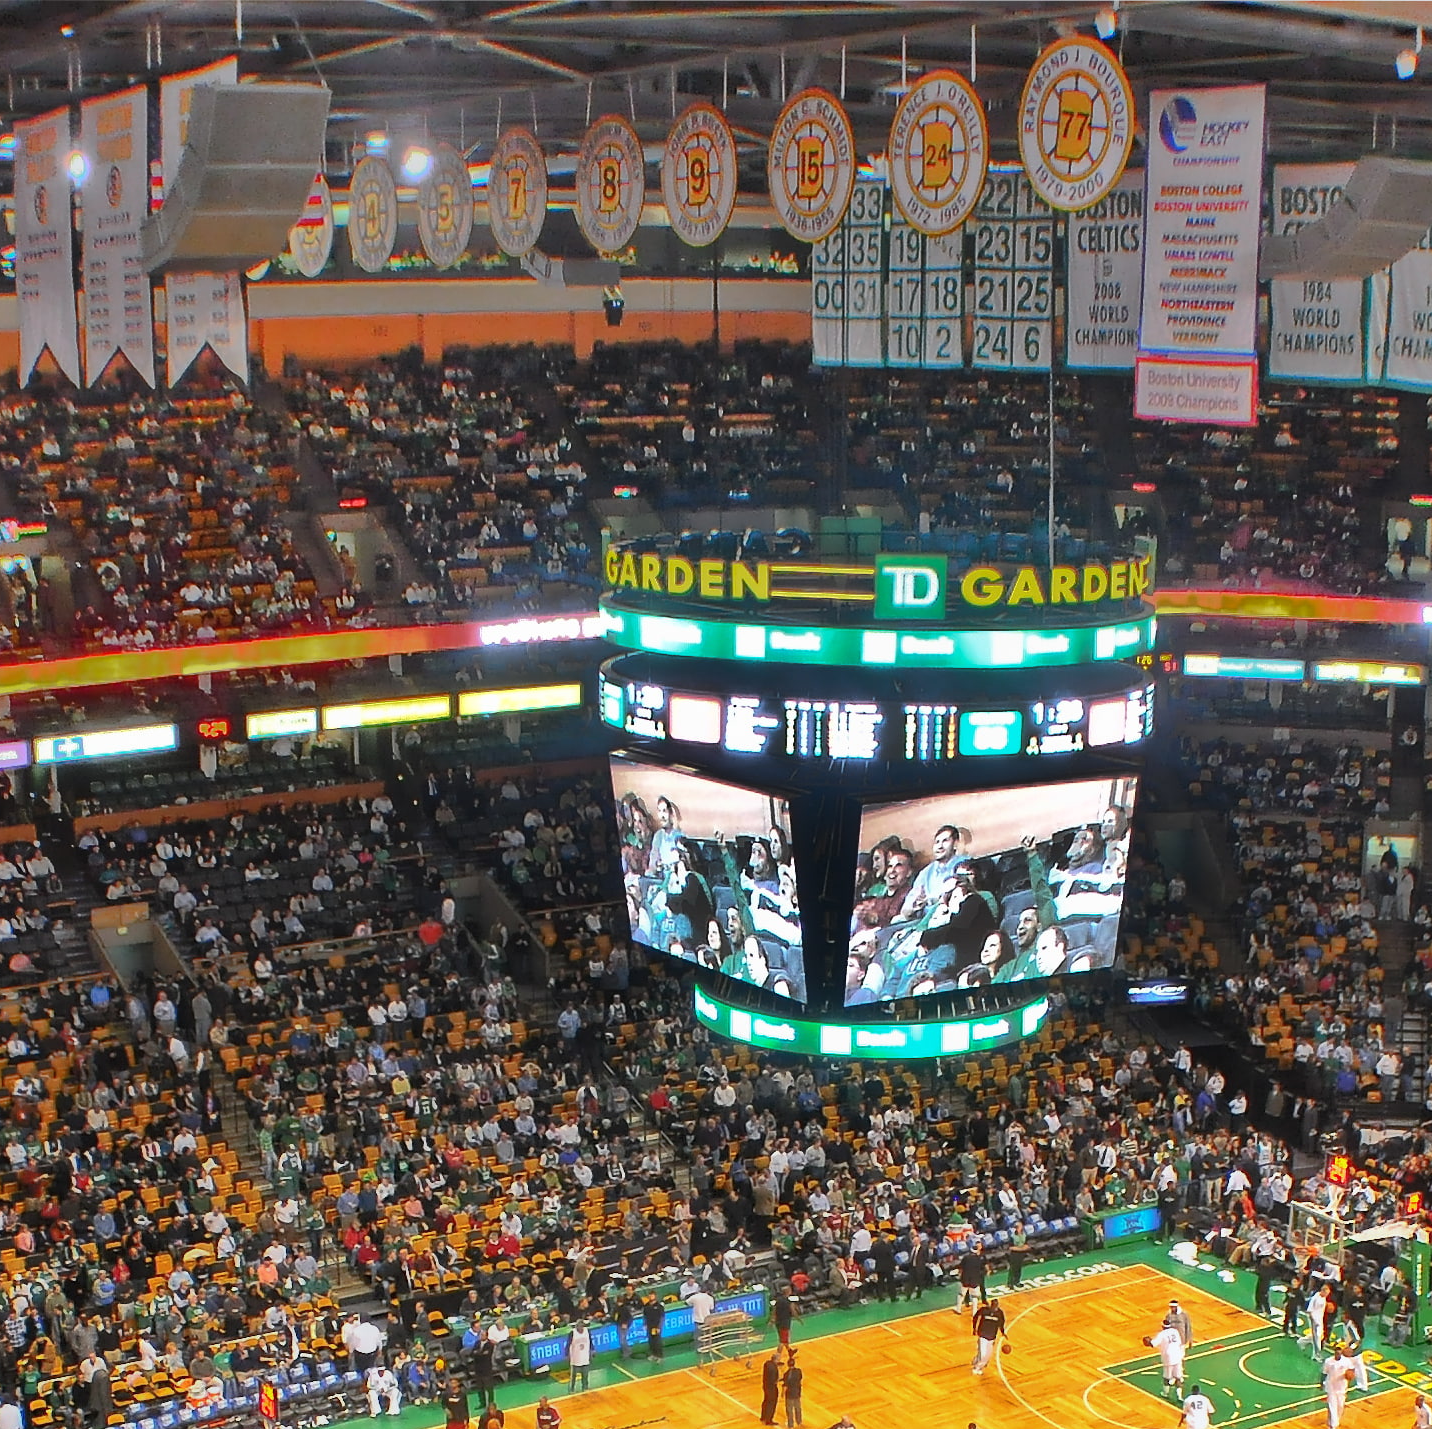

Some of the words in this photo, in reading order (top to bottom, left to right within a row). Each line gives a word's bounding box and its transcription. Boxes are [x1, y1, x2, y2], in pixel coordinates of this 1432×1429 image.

[1025, 50, 1068, 132] RAYMOND
[1089, 54, 1124, 145] BOURQUE
[1062, 111, 1089, 140] 77
[800, 150, 819, 185] 15
[926, 144, 947, 166] 24
[603, 167, 616, 199] 8
[690, 157, 704, 192] 9
[1036, 164, 1103, 200] 1979-2000
[511, 178, 521, 206] 7
[853, 187, 881, 221] 33
[985, 178, 1012, 212] 22
[1280, 186, 1343, 215] BOST
[816, 233, 843, 265] 32
[852, 232, 879, 265] 35
[896, 231, 919, 263] 19
[978, 227, 1010, 262] 23
[1021, 227, 1050, 262] 15
[1077, 224, 1140, 253] CELTICS
[815, 280, 843, 310] 00
[853, 280, 876, 312] 31
[893, 277, 920, 311] 17
[931, 276, 957, 310] 18
[979, 276, 1008, 311] 21
[1018, 276, 1048, 313] 25
[1094, 282, 1121, 300] 2008
[1303, 281, 1332, 302] 1984
[1089, 306, 1129, 323] WORLD
[1292, 307, 1340, 328] WORLD
[893, 325, 919, 357] 10
[936, 325, 951, 358] 2
[976, 324, 1007, 360] 24
[1025, 327, 1040, 361] 6
[1277, 333, 1355, 355] CHAMPIONS
[1148, 371, 1184, 386] Boston
[1187, 372, 1240, 392] University
[1176, 394, 1239, 412] Champions
[606, 548, 770, 600] GARDEN
[882, 566, 940, 607] TD
[960, 561, 1145, 607] GARDEN
[537, 1342, 561, 1360] NBA
